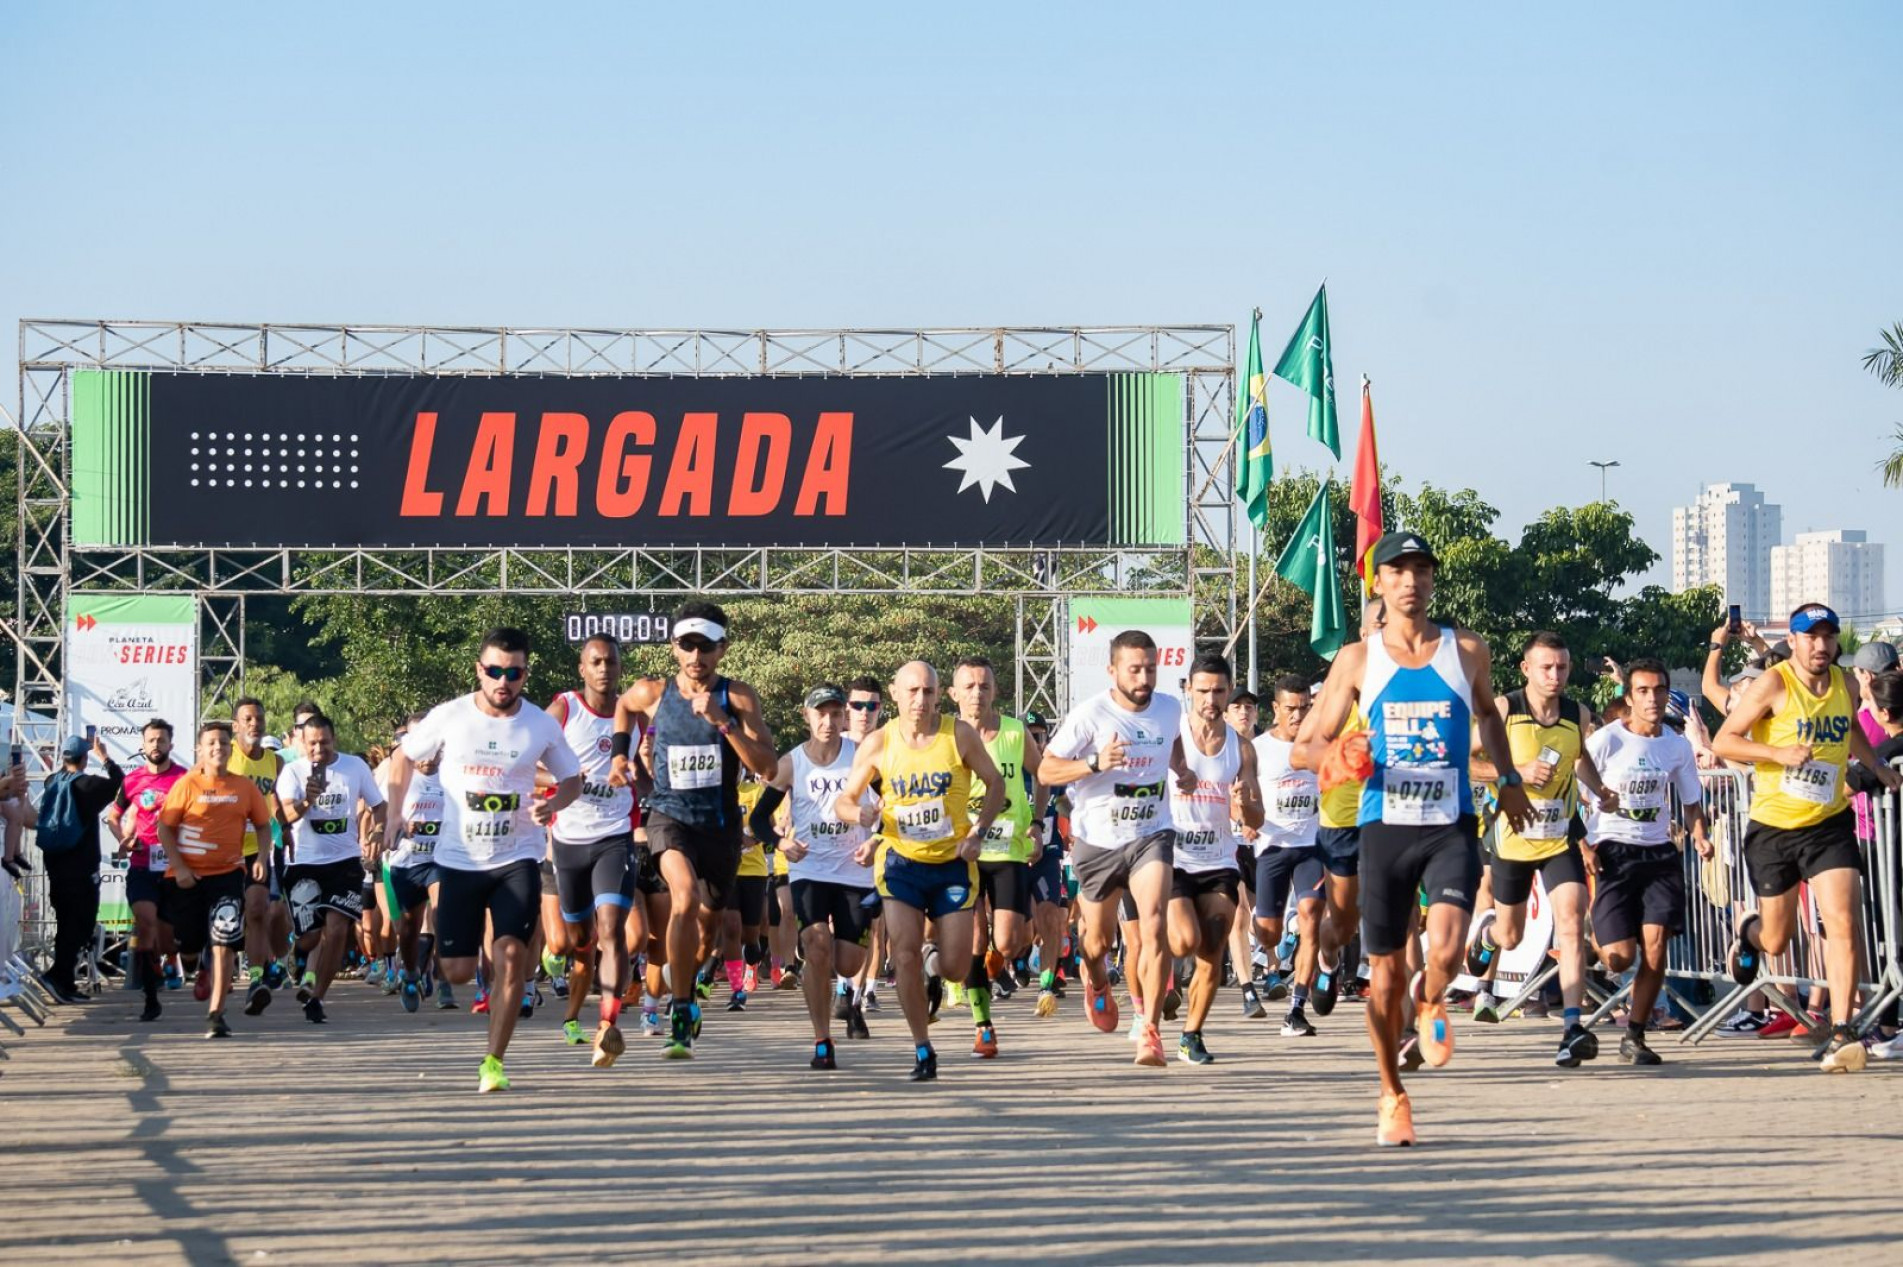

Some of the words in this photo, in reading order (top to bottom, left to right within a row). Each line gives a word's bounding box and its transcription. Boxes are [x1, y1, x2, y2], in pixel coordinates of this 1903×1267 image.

[400, 410, 854, 518] LARGADA
[120, 645, 188, 664] SERIES
[1813, 715, 1849, 743] AASP
[680, 755, 715, 771] 1282
[582, 782, 614, 798] 0415
[909, 771, 952, 798] AASP
[1400, 780, 1445, 801] 0778
[1473, 786, 1485, 799] 52
[1284, 795, 1311, 808] 1050
[908, 807, 939, 827] 1180
[1120, 804, 1155, 821] 0546
[1537, 807, 1560, 823] 578
[475, 820, 510, 836] 1116
[986, 826, 1003, 840] 62
[1185, 830, 1215, 845] 0570
